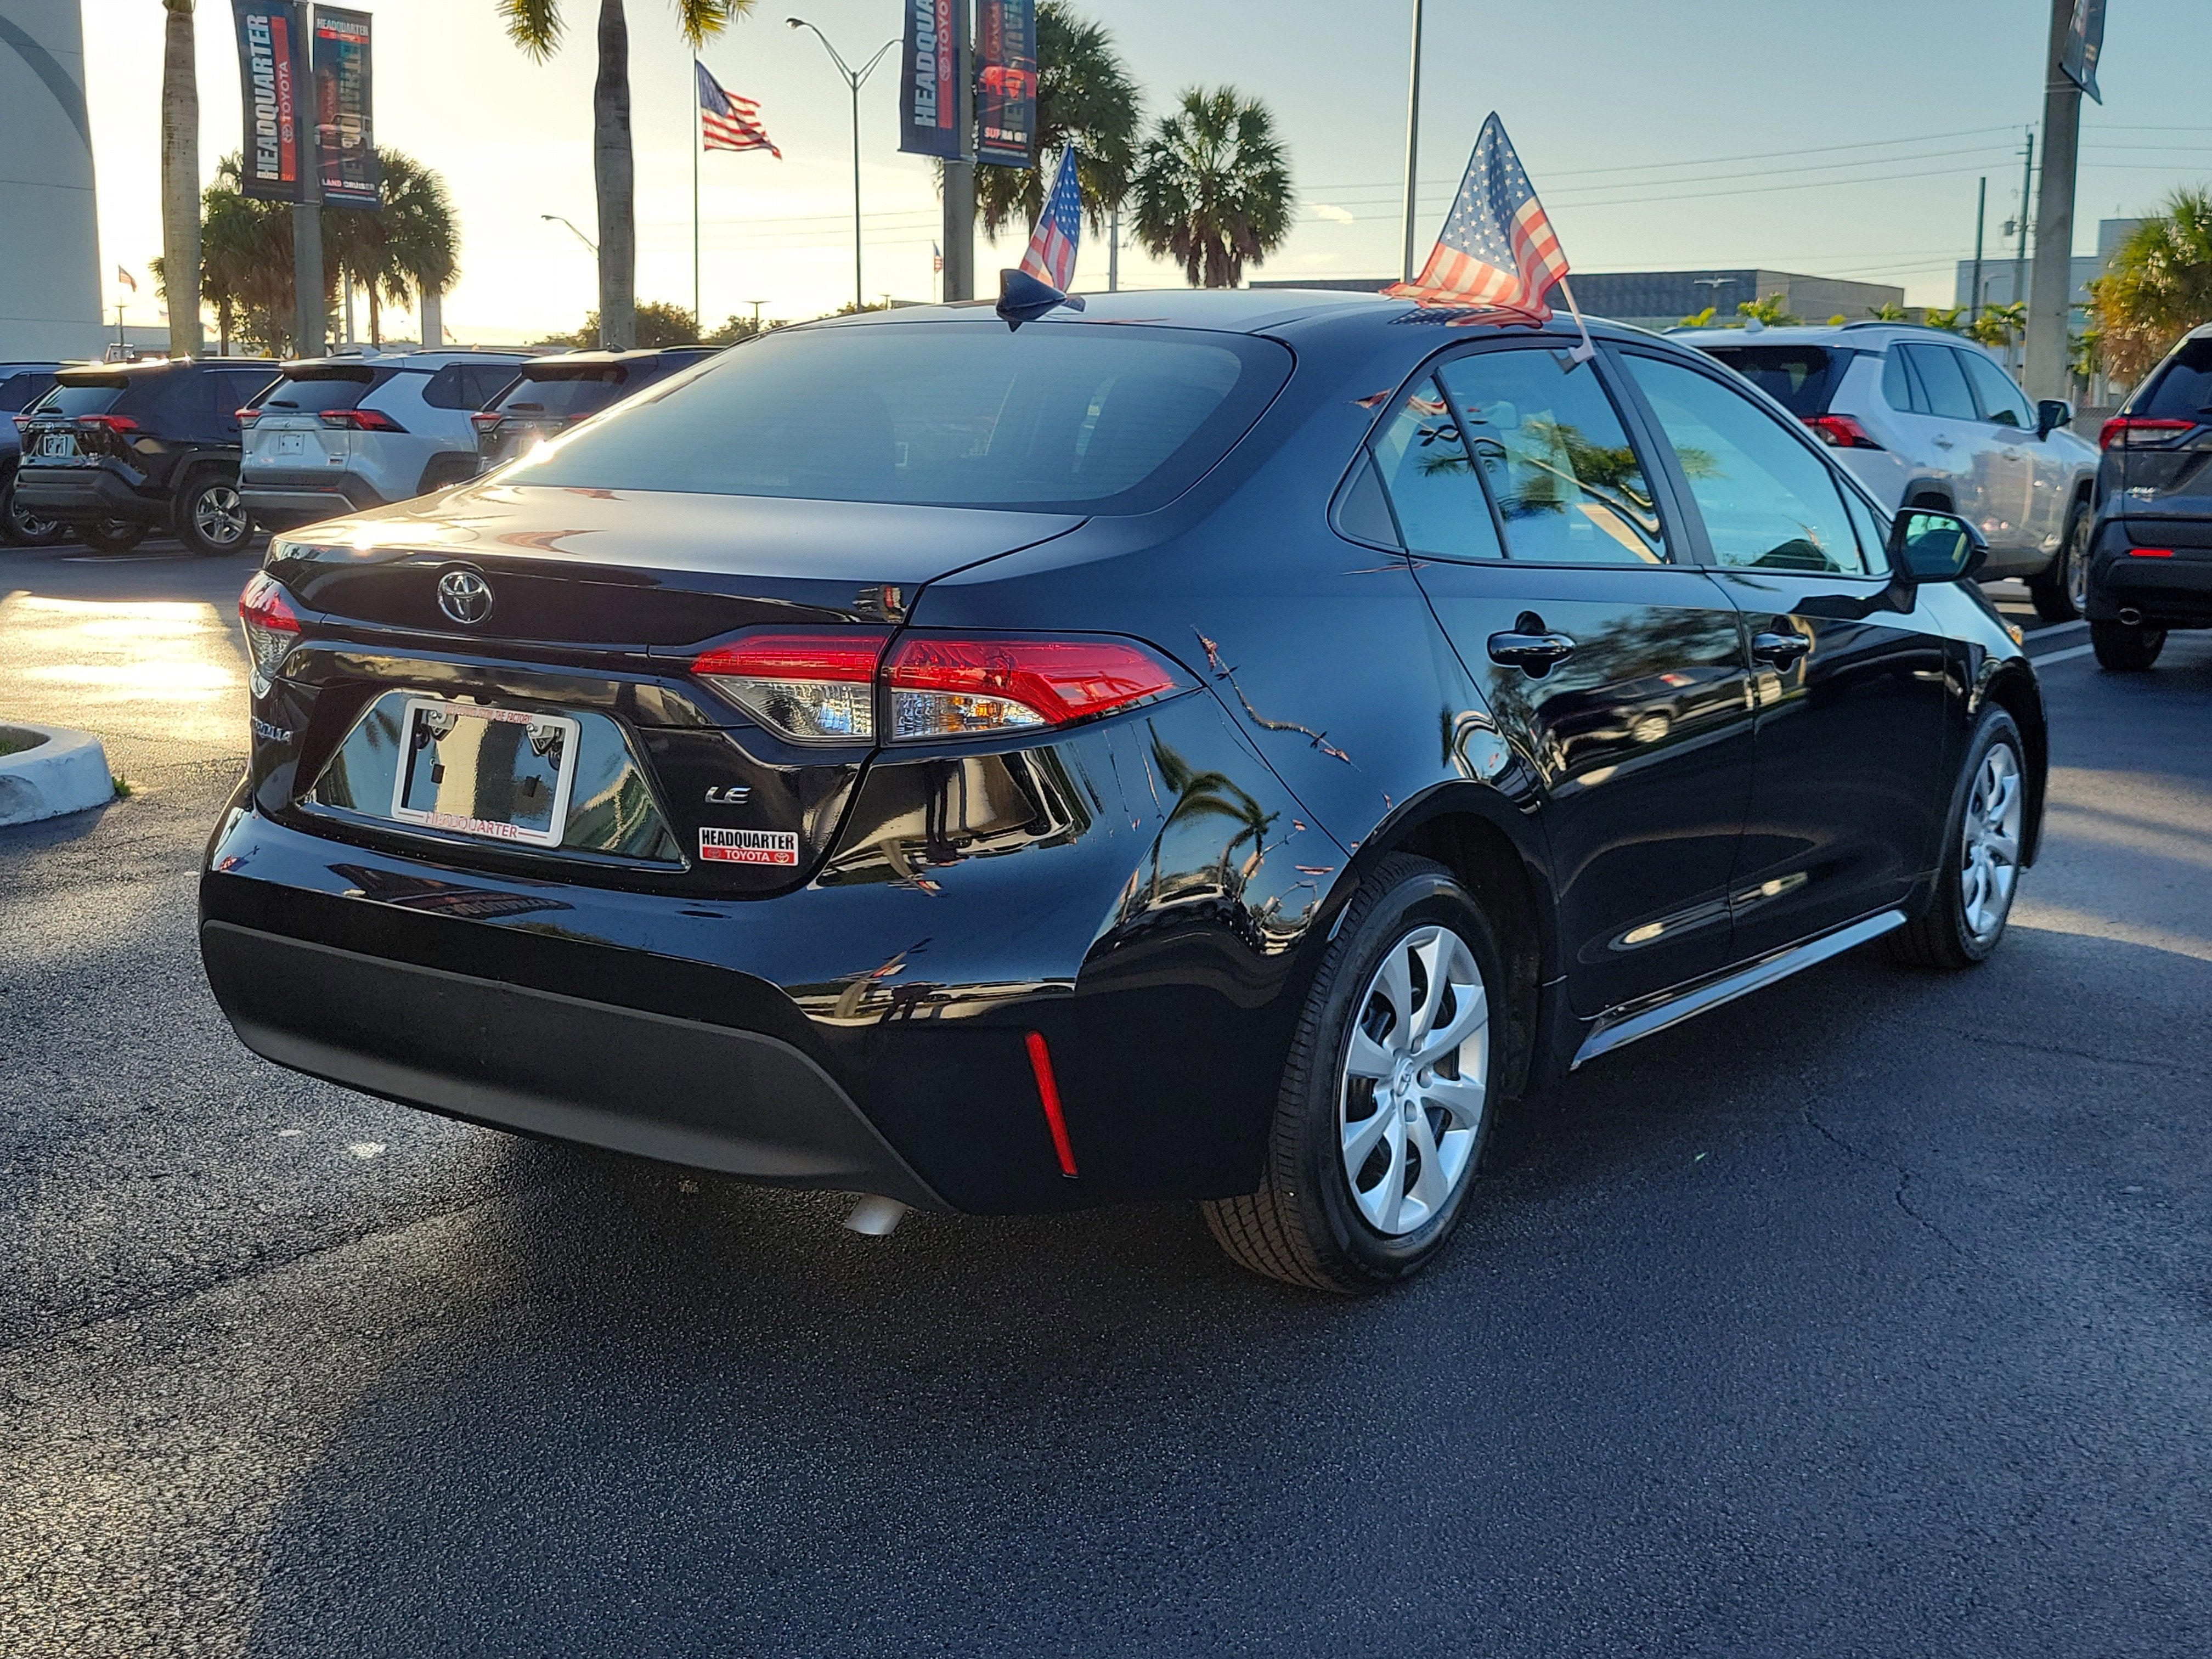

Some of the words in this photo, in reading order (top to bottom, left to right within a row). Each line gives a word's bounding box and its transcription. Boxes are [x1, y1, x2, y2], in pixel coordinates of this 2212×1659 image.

[247, 14, 279, 180] HEADQUARTER
[279, 60, 292, 122] TOYOTA
[705, 786, 752, 804] LE
[426, 812, 517, 838] HEADQUARTER
[702, 829, 794, 850] HEADQUARTER
[725, 849, 770, 862] TOYOTA
